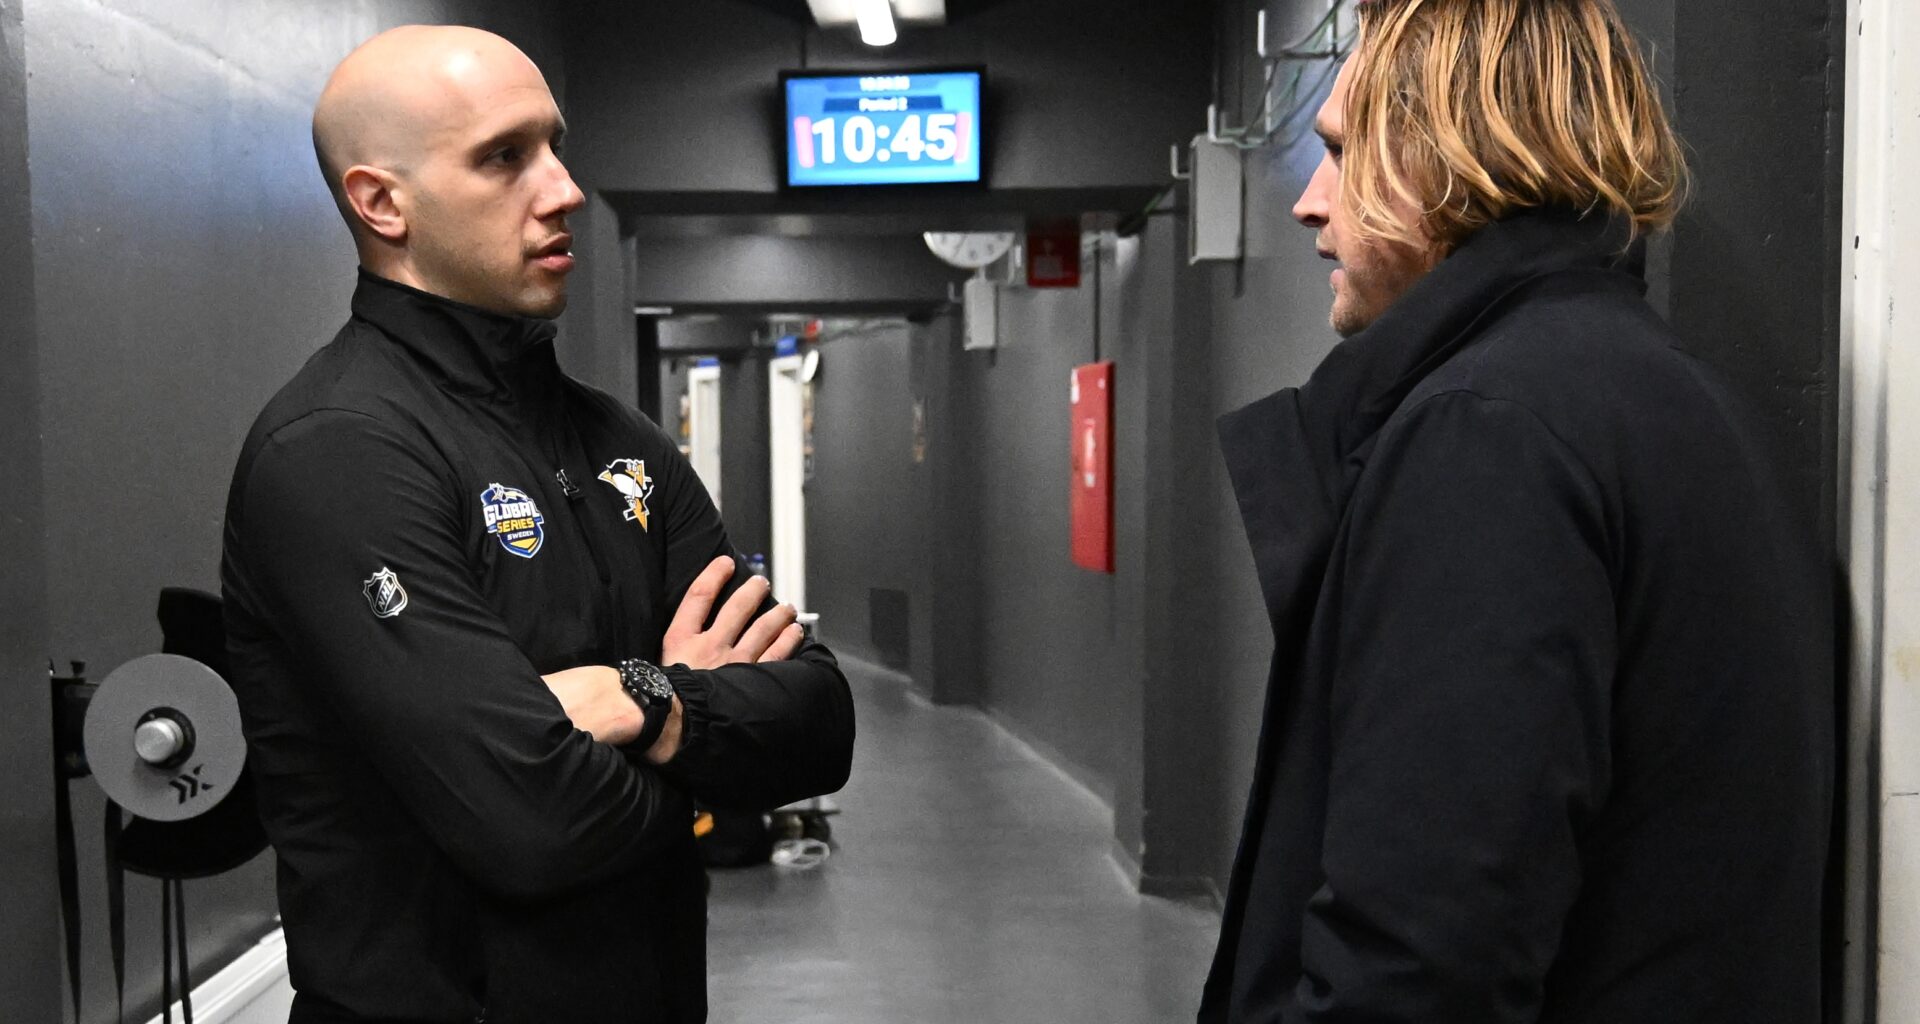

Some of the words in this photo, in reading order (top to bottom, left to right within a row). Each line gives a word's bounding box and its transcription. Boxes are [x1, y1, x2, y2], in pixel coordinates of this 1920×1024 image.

[811, 113, 957, 164] 10:45
[483, 500, 541, 527] GLOBAL
[497, 518, 535, 534] SERIES
[507, 530, 534, 541] SWEDEN
[378, 580, 395, 611] NHL
